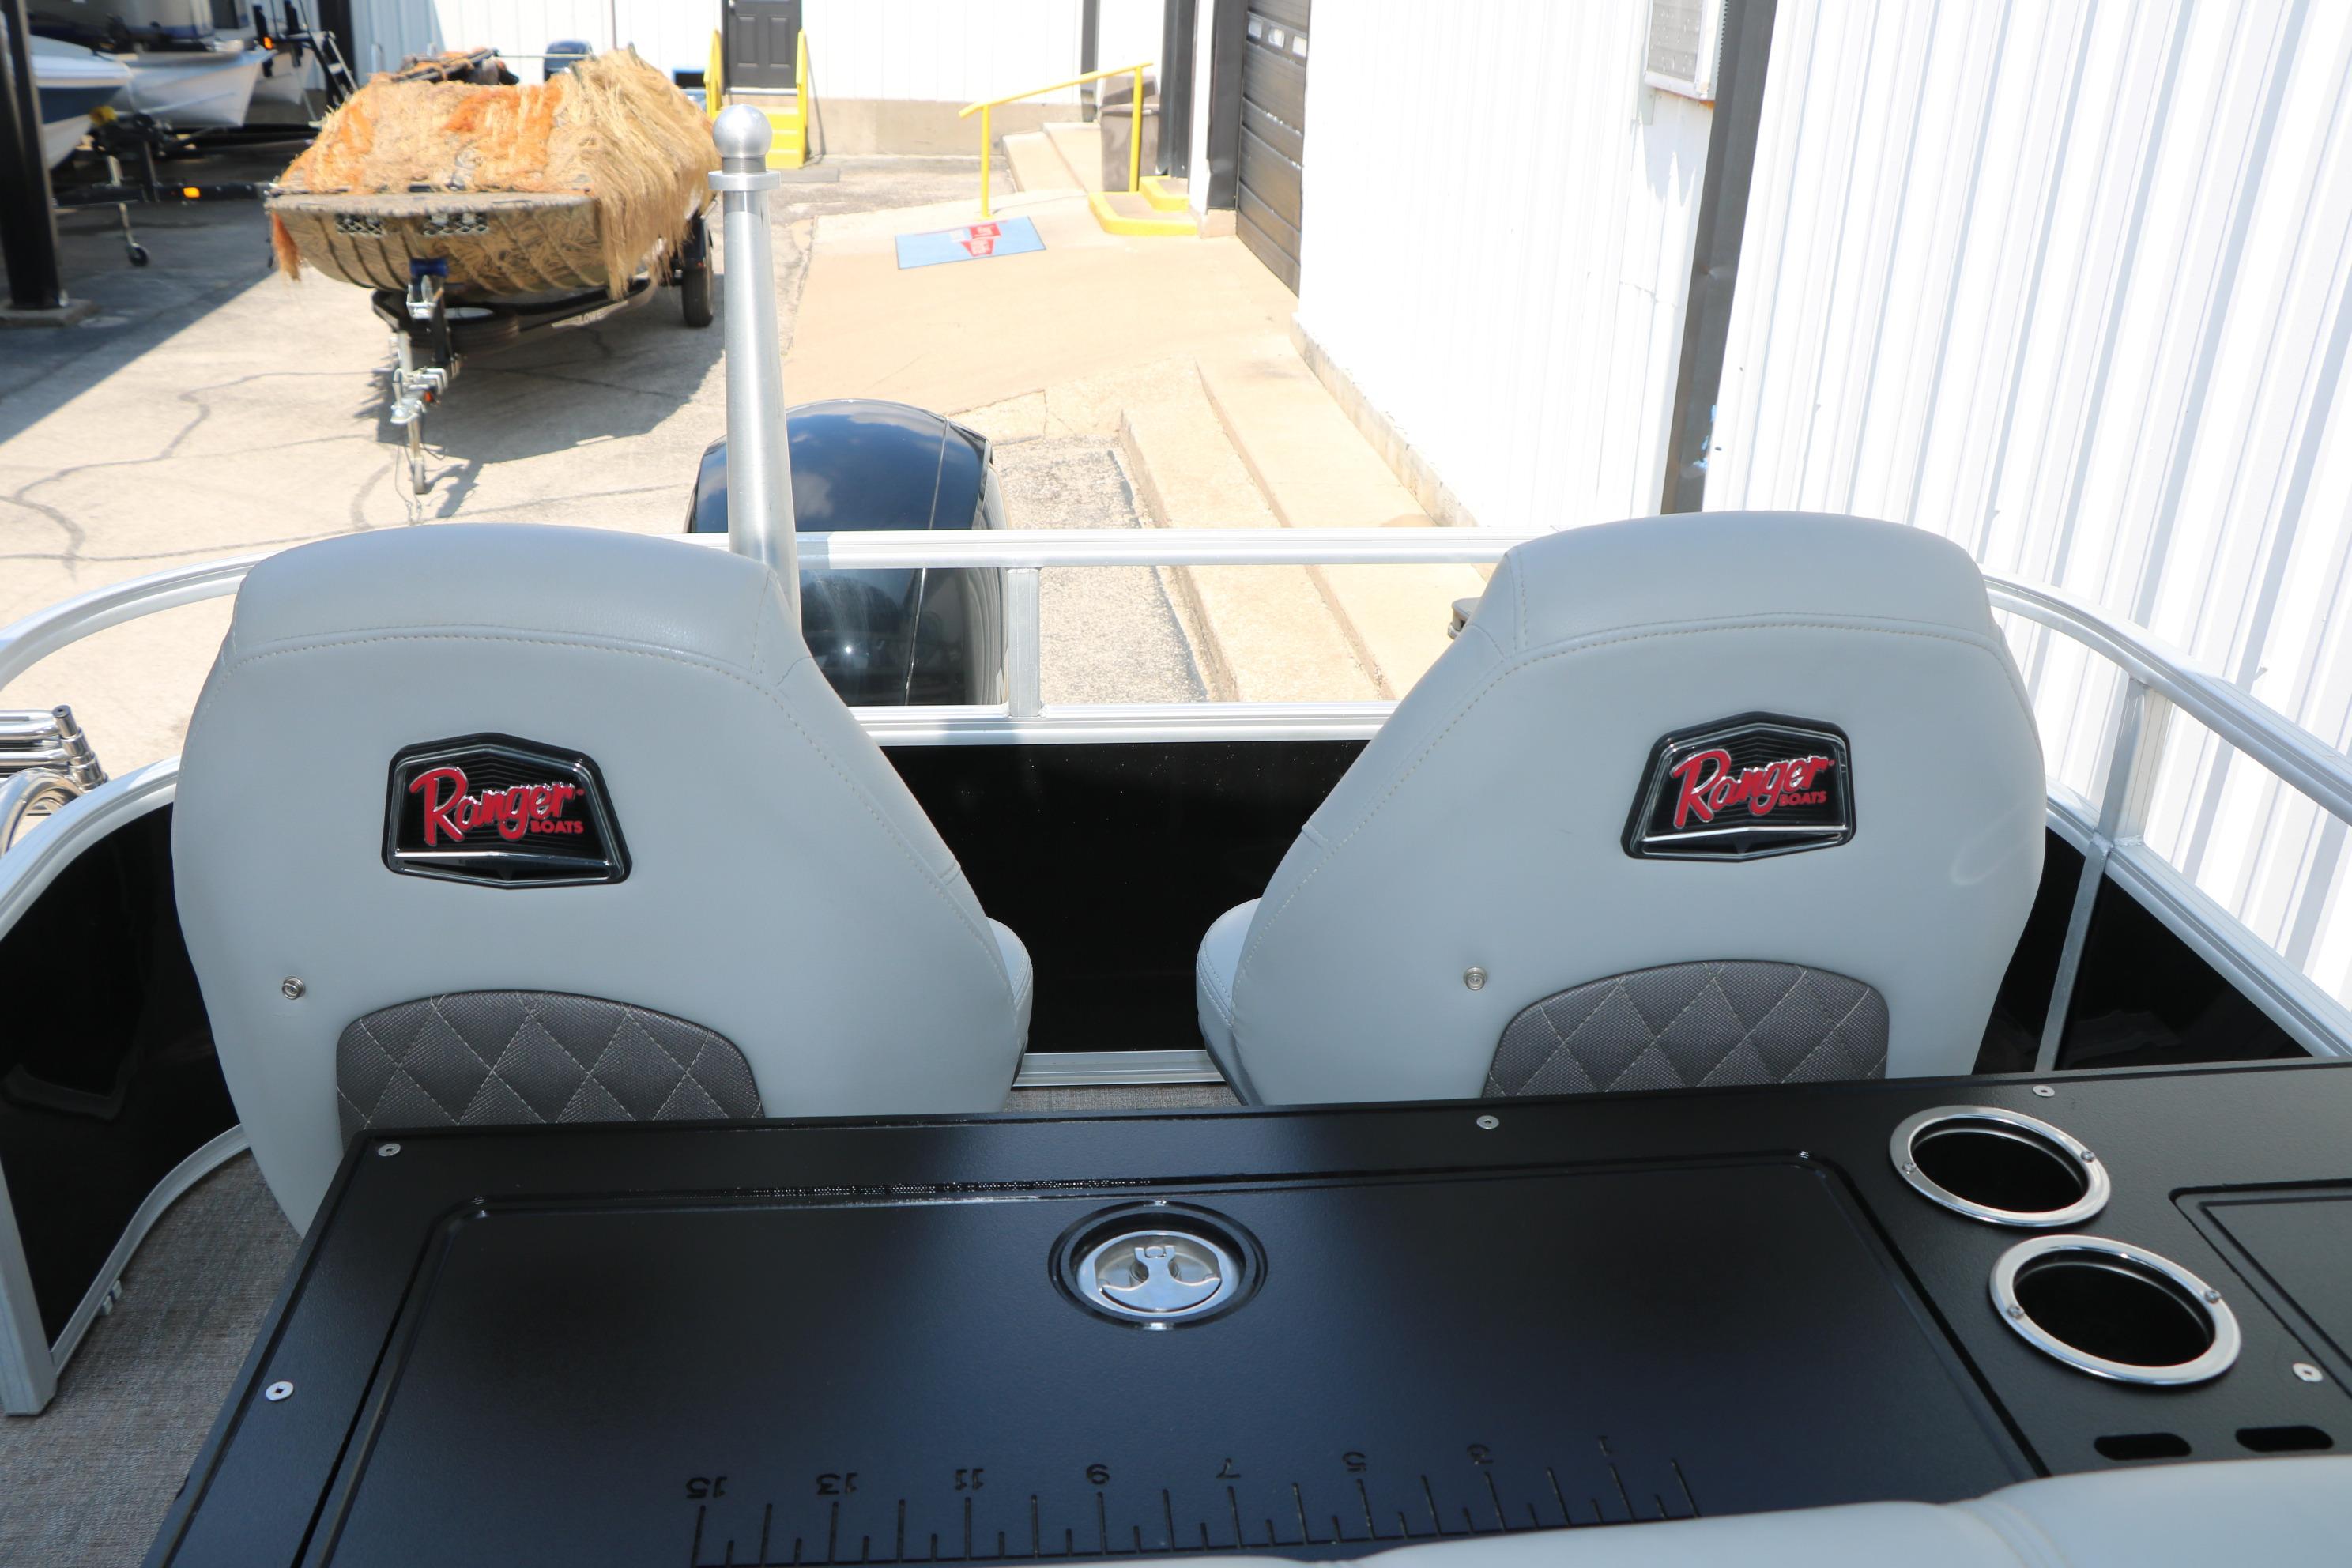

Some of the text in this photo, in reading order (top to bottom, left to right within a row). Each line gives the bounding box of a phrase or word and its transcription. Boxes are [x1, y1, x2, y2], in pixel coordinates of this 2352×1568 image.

[1670, 748, 1829, 829] Ranger
[1779, 791, 1826, 806] BOATS
[409, 766, 575, 846] Ranger
[530, 820, 584, 834] BOATS
[1216, 1457, 1241, 1479] 7
[1342, 1451, 1367, 1472] 5
[816, 1472, 858, 1495] 13
[955, 1468, 984, 1491] 11
[1085, 1464, 1110, 1485] 9
[685, 1476, 728, 1498] 15
